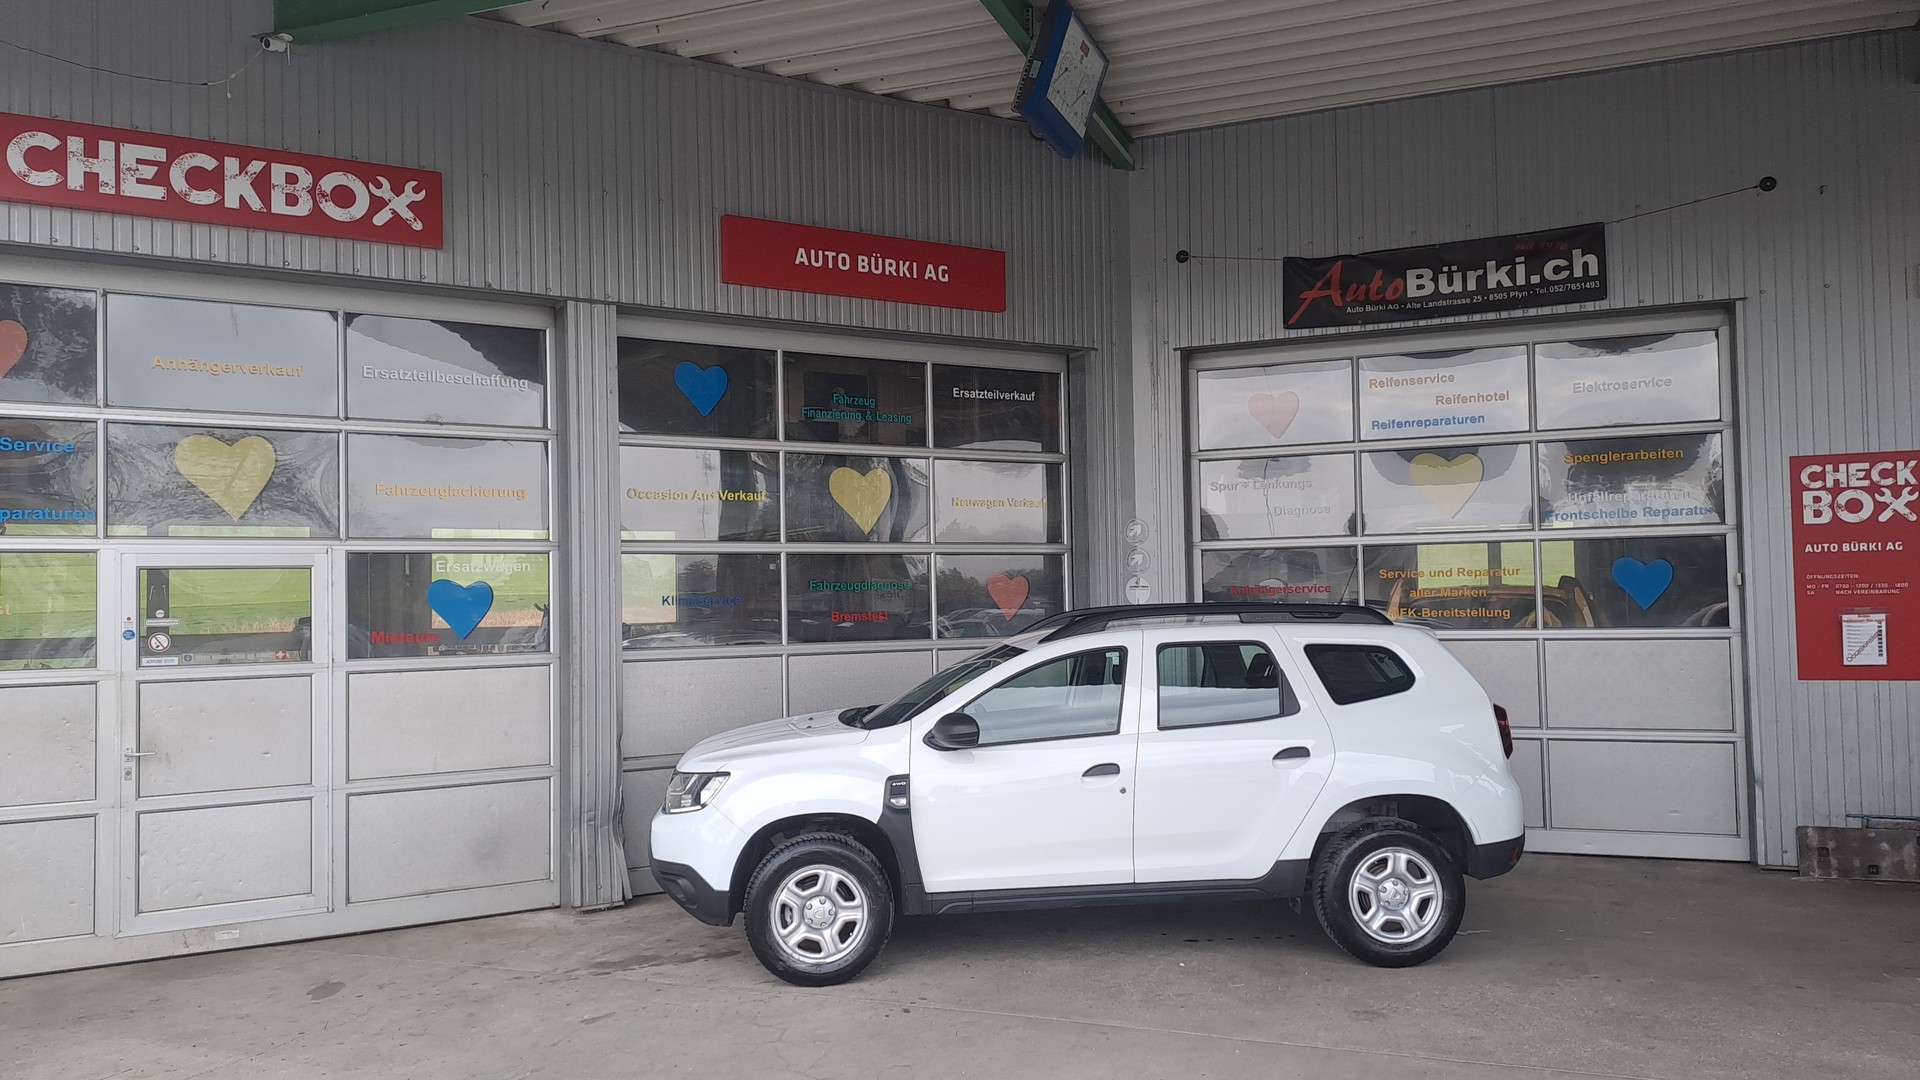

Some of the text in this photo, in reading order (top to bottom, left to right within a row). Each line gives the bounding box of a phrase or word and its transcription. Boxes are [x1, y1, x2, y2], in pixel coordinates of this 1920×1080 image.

[6, 131, 427, 231] CHECKBOX
[794, 247, 950, 283] AUTO BÜRKI AG
[1346, 306, 1364, 314] Auto
[1366, 304, 1386, 313] Bürki
[1387, 303, 1399, 311] AG
[1406, 301, 1421, 309] Alte
[1423, 297, 1471, 308] Landstrasse
[1472, 295, 1482, 304] 25
[1489, 293, 1508, 301] 8505
[1509, 290, 1528, 300] Pfyn
[151, 355, 304, 378] Anhängerverkauf
[362, 365, 529, 392] Ersatzteilbeschaffung
[1368, 372, 1455, 389] Reifenservice
[1572, 376, 1672, 394] Elektroservice
[833, 393, 876, 408] Fahrzeug
[952, 387, 1036, 402] Ersatzteilverkauf
[1435, 391, 1509, 406] Reifenhotel
[801, 407, 912, 425] Finanzierung & Leasing
[1371, 413, 1486, 431] Reifenreparaturen
[0, 436, 75, 453] Service
[1564, 446, 1684, 466] Spenglerarbeiten
[1800, 460, 1920, 489] CHECK
[375, 481, 527, 503] Fahrzeuglackierung
[626, 487, 688, 501] Occasion
[1210, 481, 1238, 493] Spur
[1253, 479, 1312, 491] Lenkungs
[1273, 505, 1331, 517] Diagnose
[1545, 507, 1638, 521] Frontscheibe
[1804, 540, 1904, 553] AUTO BÜRKI AG
[435, 560, 531, 575] Ersatzwagen
[1379, 567, 1521, 579] Service und Reparatur
[809, 580, 911, 593] Fahrzeugdiagnose
[1410, 588, 1487, 598] aller Marken
[831, 610, 889, 622] Bremstest
